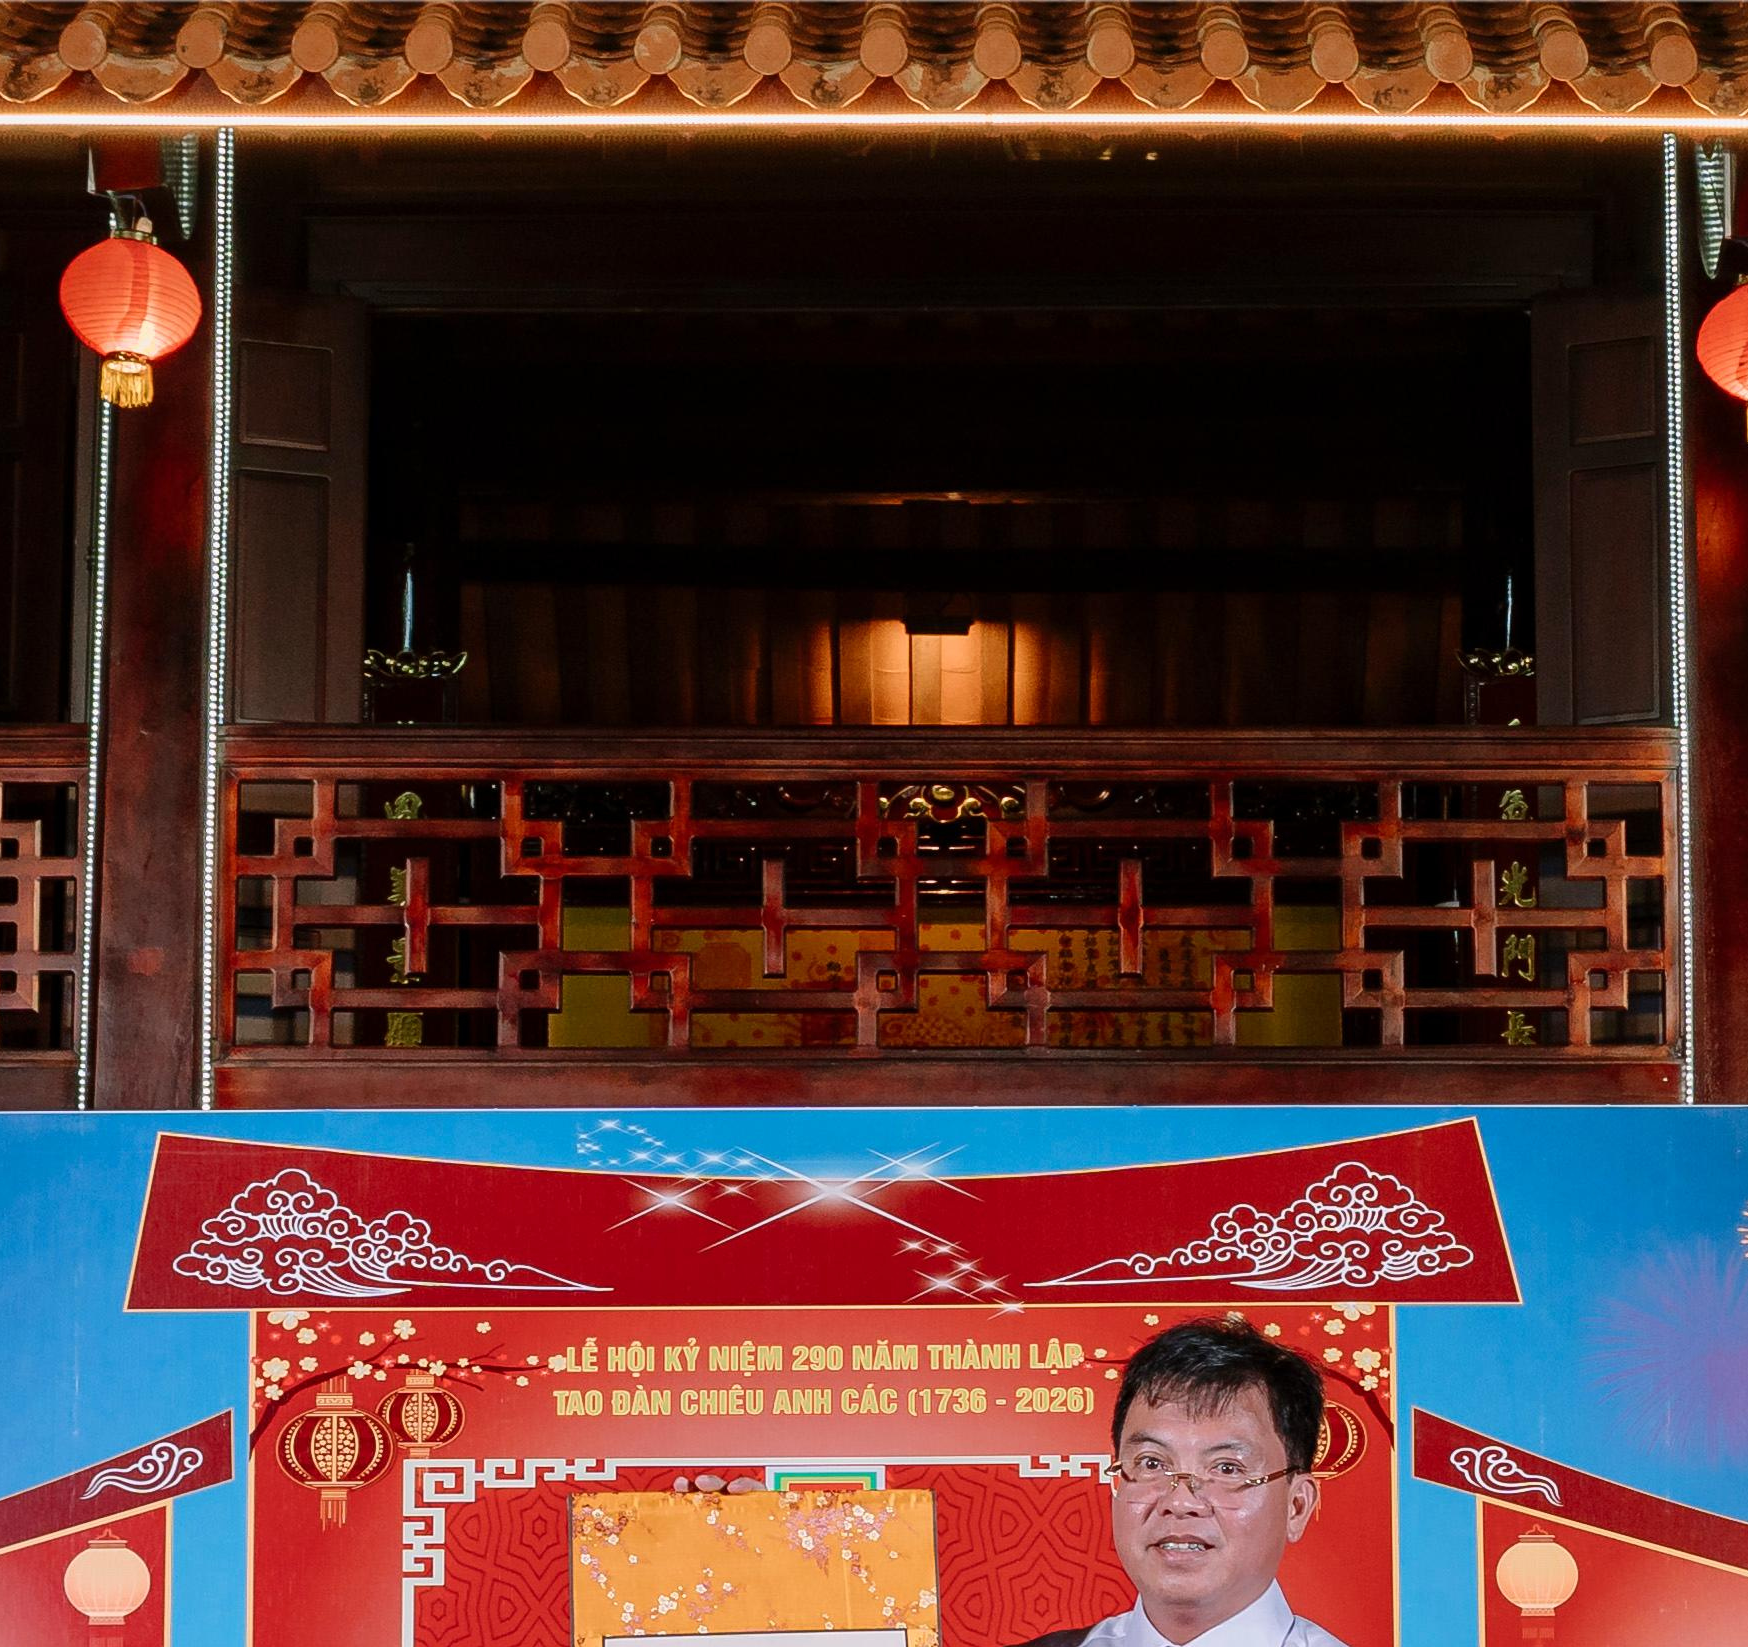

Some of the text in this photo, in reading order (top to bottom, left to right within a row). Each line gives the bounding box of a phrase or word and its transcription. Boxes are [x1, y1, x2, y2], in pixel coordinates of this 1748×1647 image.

[566, 1337, 1084, 1377] LỄ HỘI KỶ NIỆM 290 NĂM THÀNH LẬP
[553, 1389, 603, 1416] TAO
[611, 1384, 671, 1416] ĐÀN
[680, 1384, 764, 1416] CHIÊU
[772, 1388, 832, 1415] ANH
[841, 1383, 898, 1414] CÁC
[907, 1388, 987, 1416] (1736
[1015, 1387, 1094, 1415] 2026)
